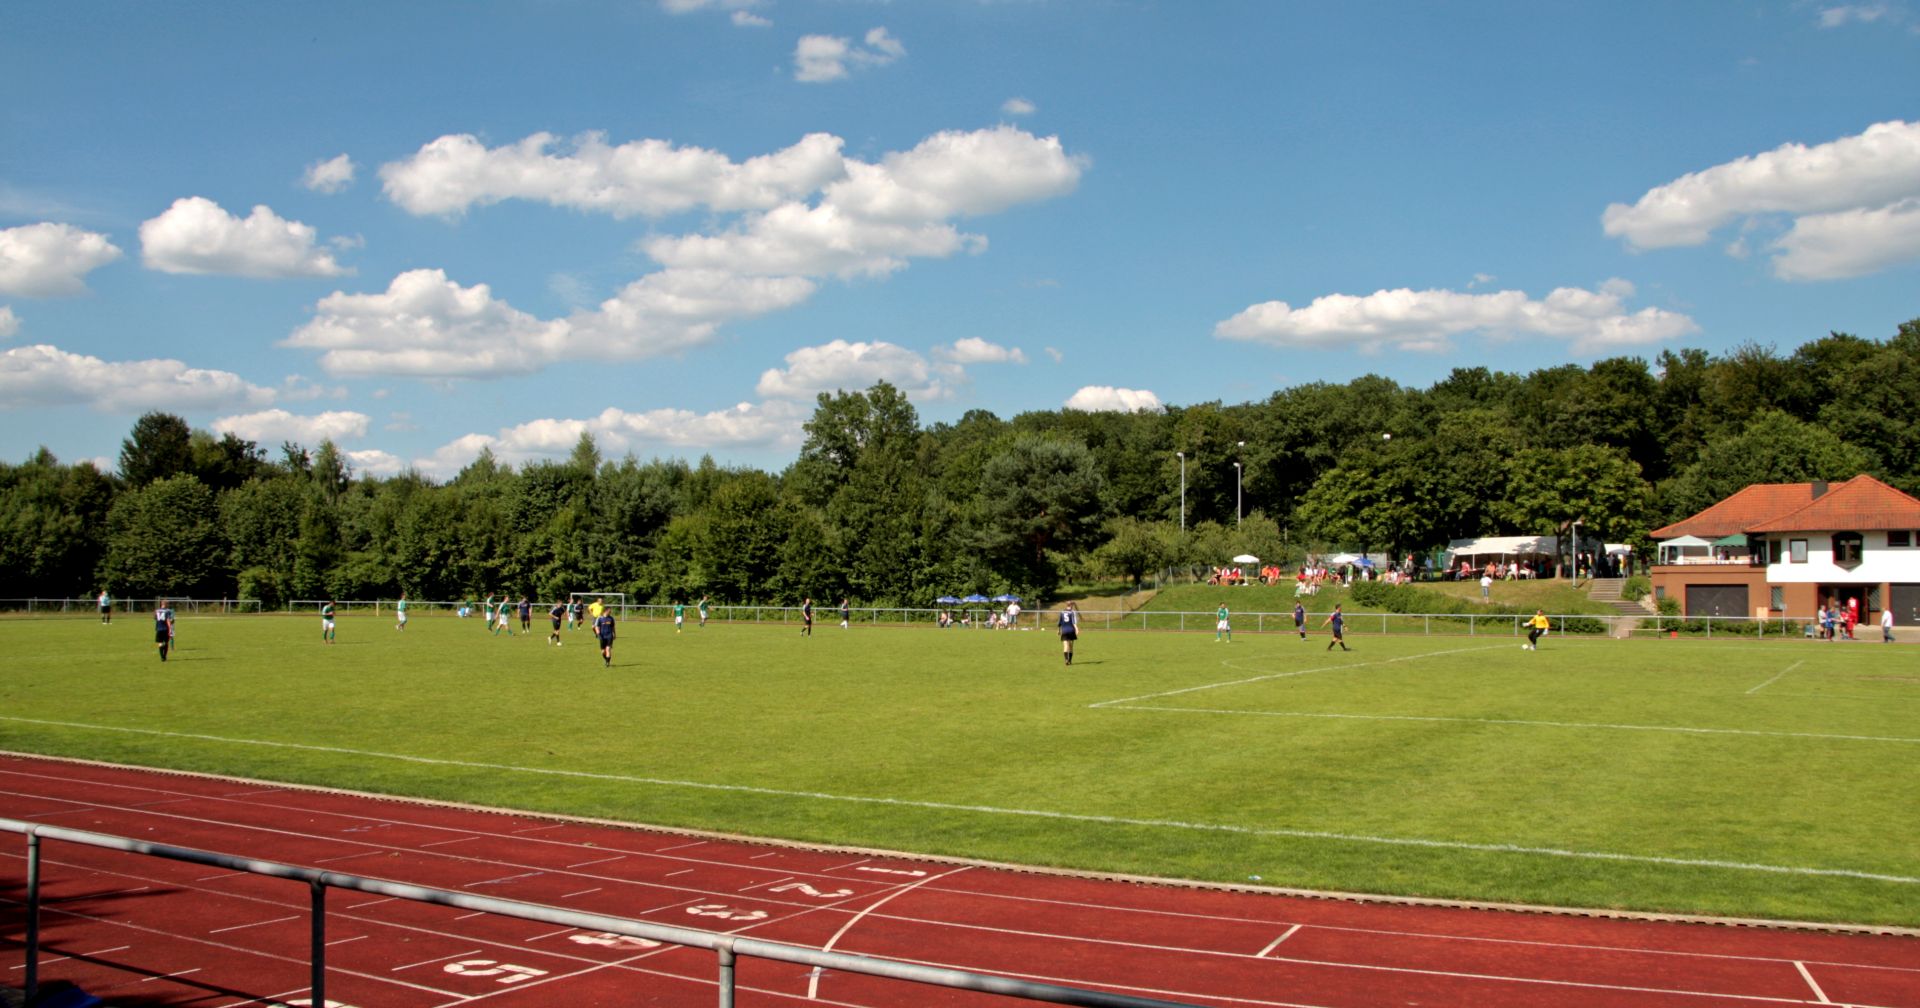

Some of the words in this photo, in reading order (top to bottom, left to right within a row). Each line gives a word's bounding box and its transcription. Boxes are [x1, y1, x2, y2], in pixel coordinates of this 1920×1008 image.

[1063, 612, 1070, 622] 5
[768, 883, 854, 898] 2
[686, 904, 768, 920] 3
[443, 960, 549, 983] 5
